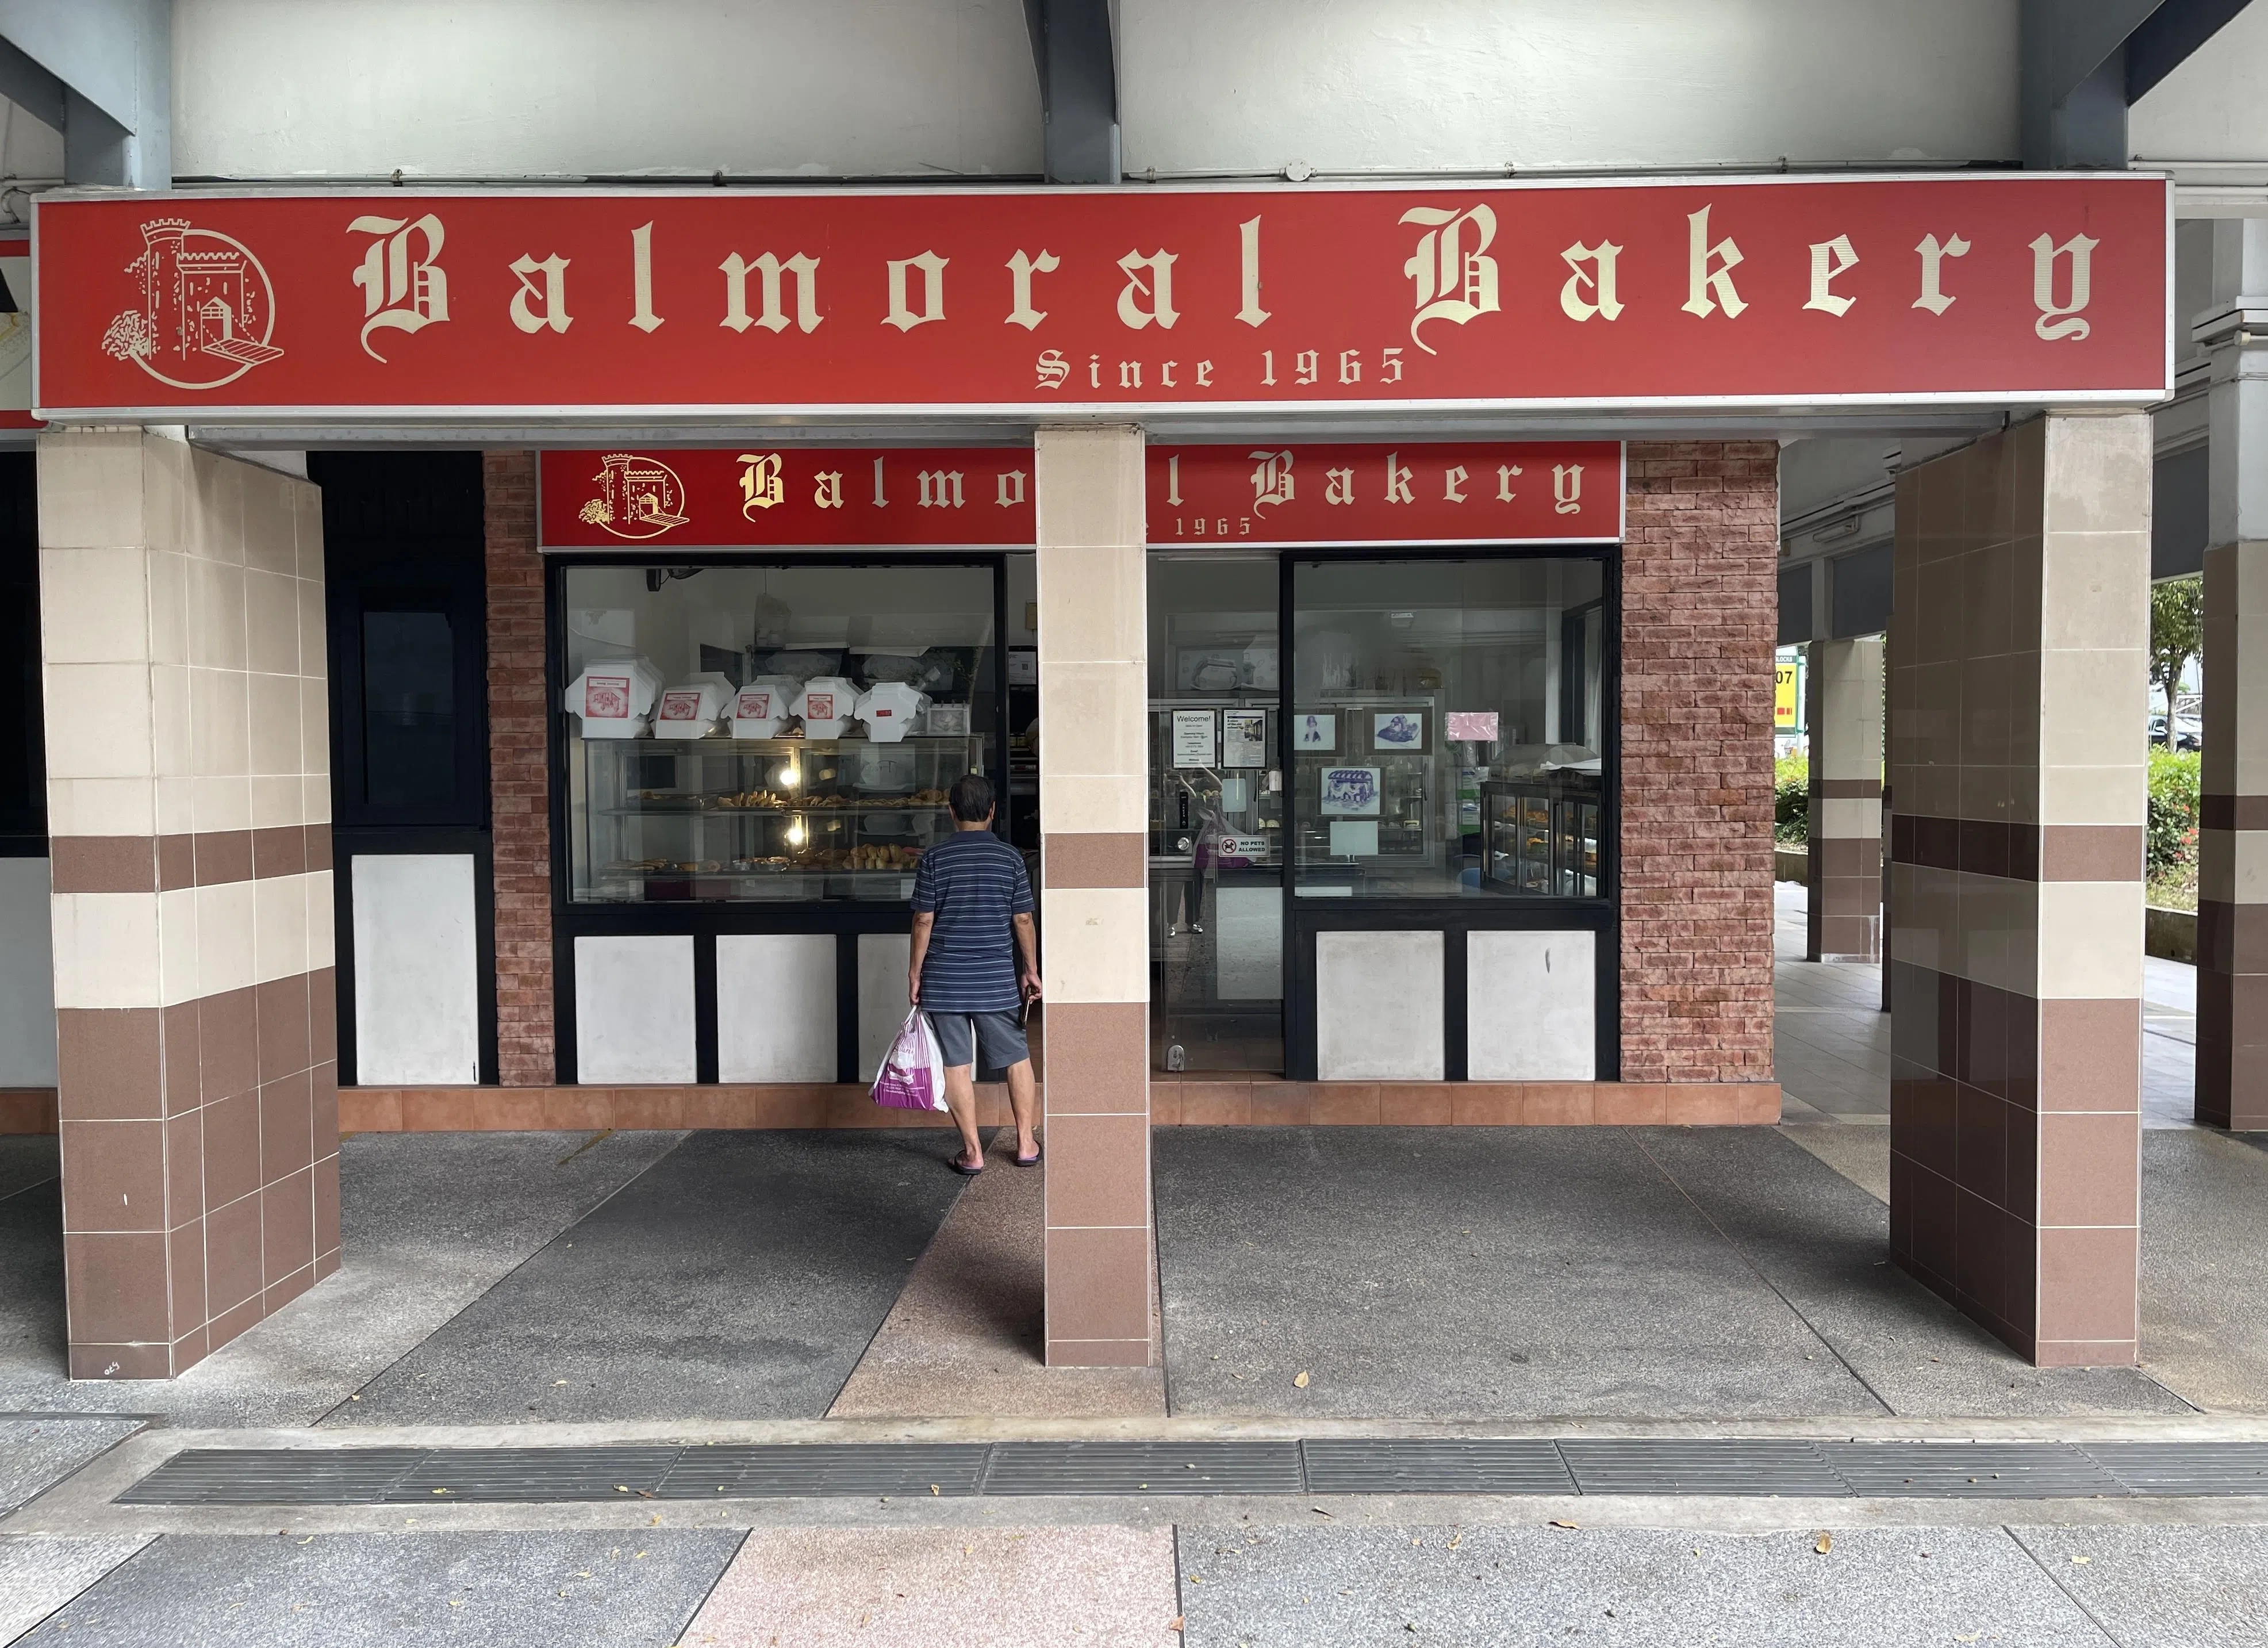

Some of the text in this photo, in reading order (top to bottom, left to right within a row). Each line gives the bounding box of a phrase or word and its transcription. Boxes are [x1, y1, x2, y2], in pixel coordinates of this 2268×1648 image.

[346, 202, 2100, 364] Balmoral Bakery
[1034, 348, 1404, 389] Since 1965
[1249, 450, 1585, 520] Bakery
[1175, 517, 1250, 536] 1965
